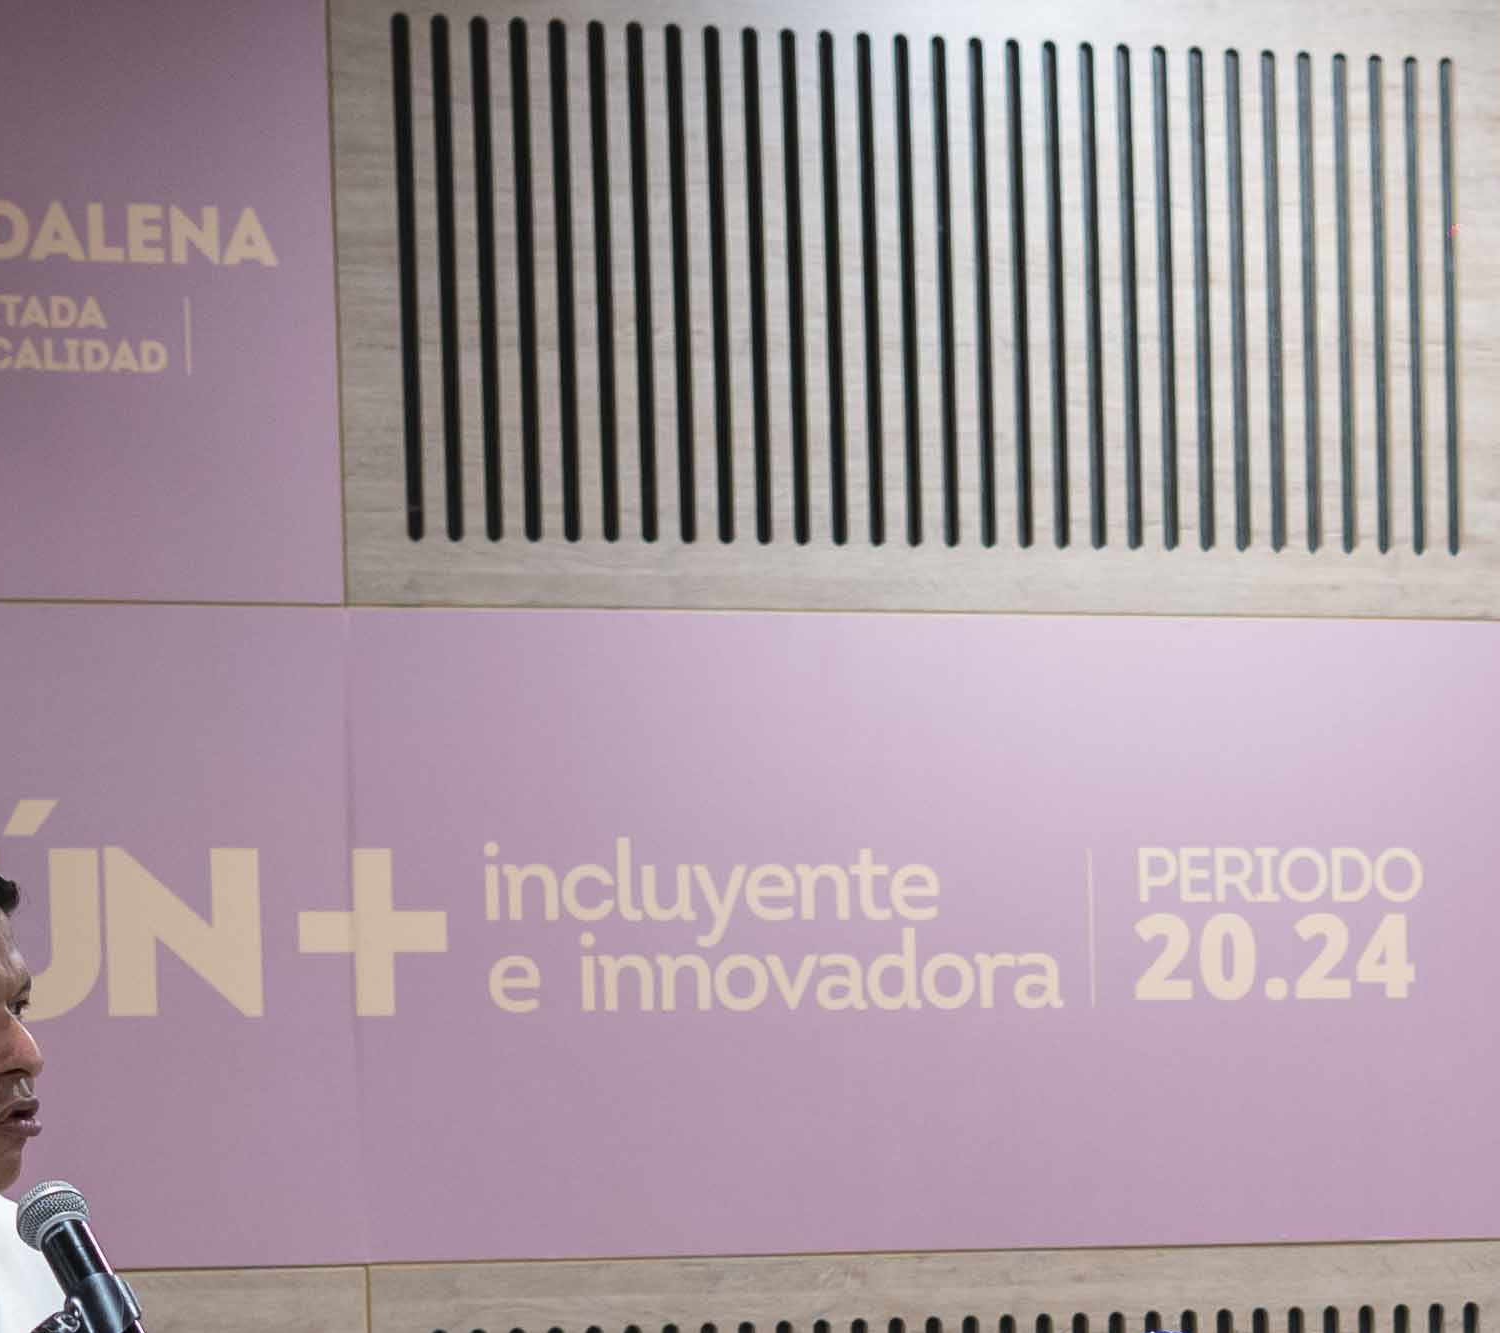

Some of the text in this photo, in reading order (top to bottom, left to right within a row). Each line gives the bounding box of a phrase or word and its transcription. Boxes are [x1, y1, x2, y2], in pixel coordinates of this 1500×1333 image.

[484, 837, 940, 946] incluyente
[1137, 846, 1423, 904] PERIODO
[488, 928, 1064, 1012] e innovadora
[1134, 912, 1416, 1000] 20.24
